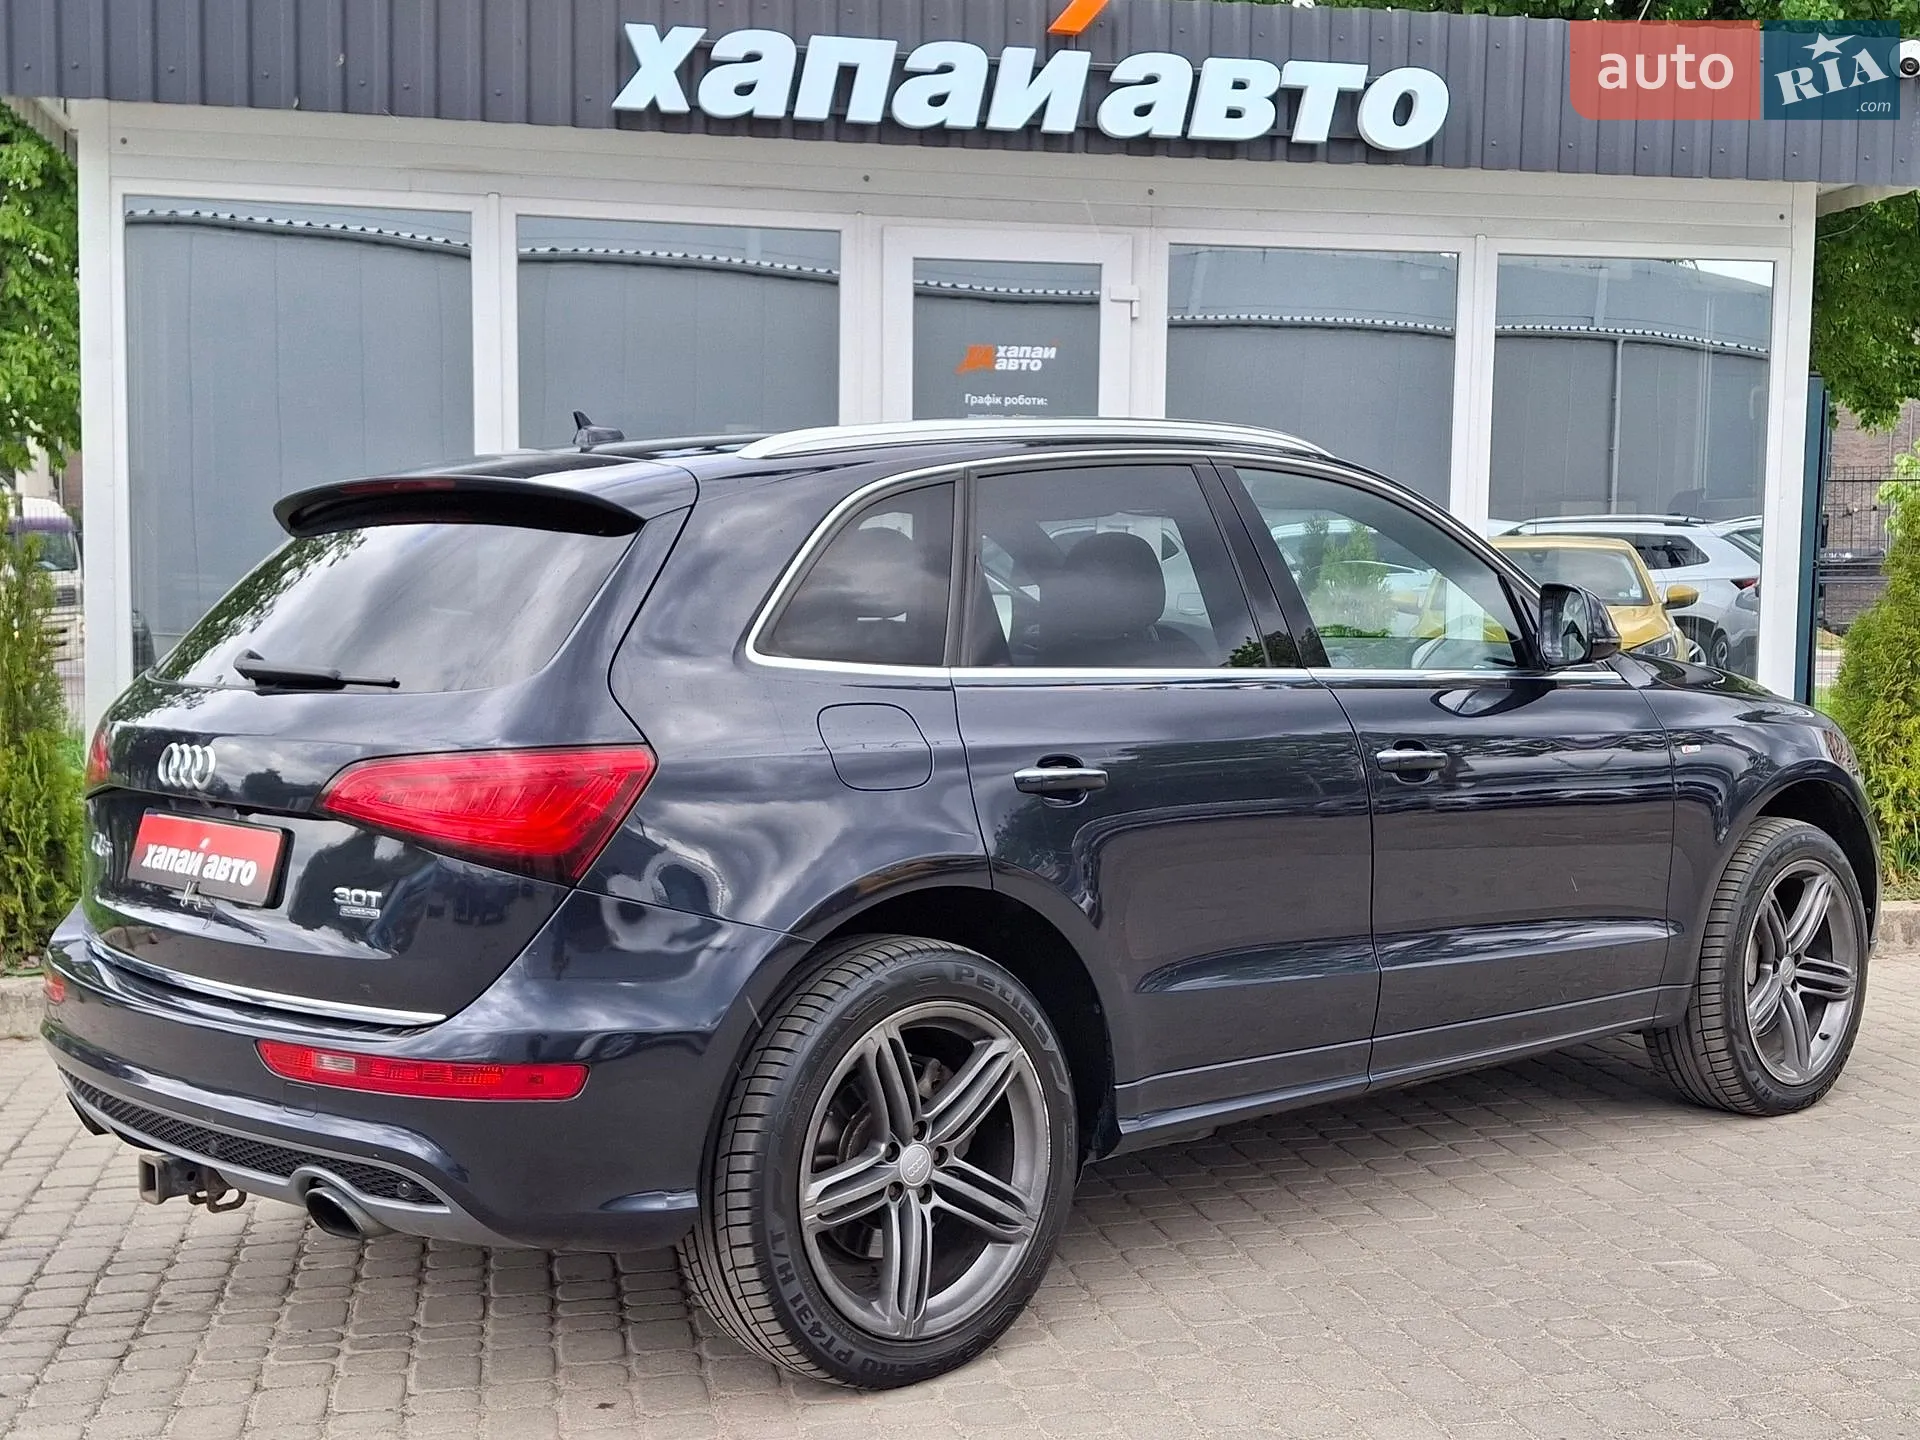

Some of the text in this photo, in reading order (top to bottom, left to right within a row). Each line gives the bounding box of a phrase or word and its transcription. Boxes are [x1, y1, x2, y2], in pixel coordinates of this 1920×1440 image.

[1097, 51, 1450, 151] авто
[995, 358, 1042, 371] авто
[964, 393, 1048, 407] Графік роботи:
[202, 854, 257, 887] авто
